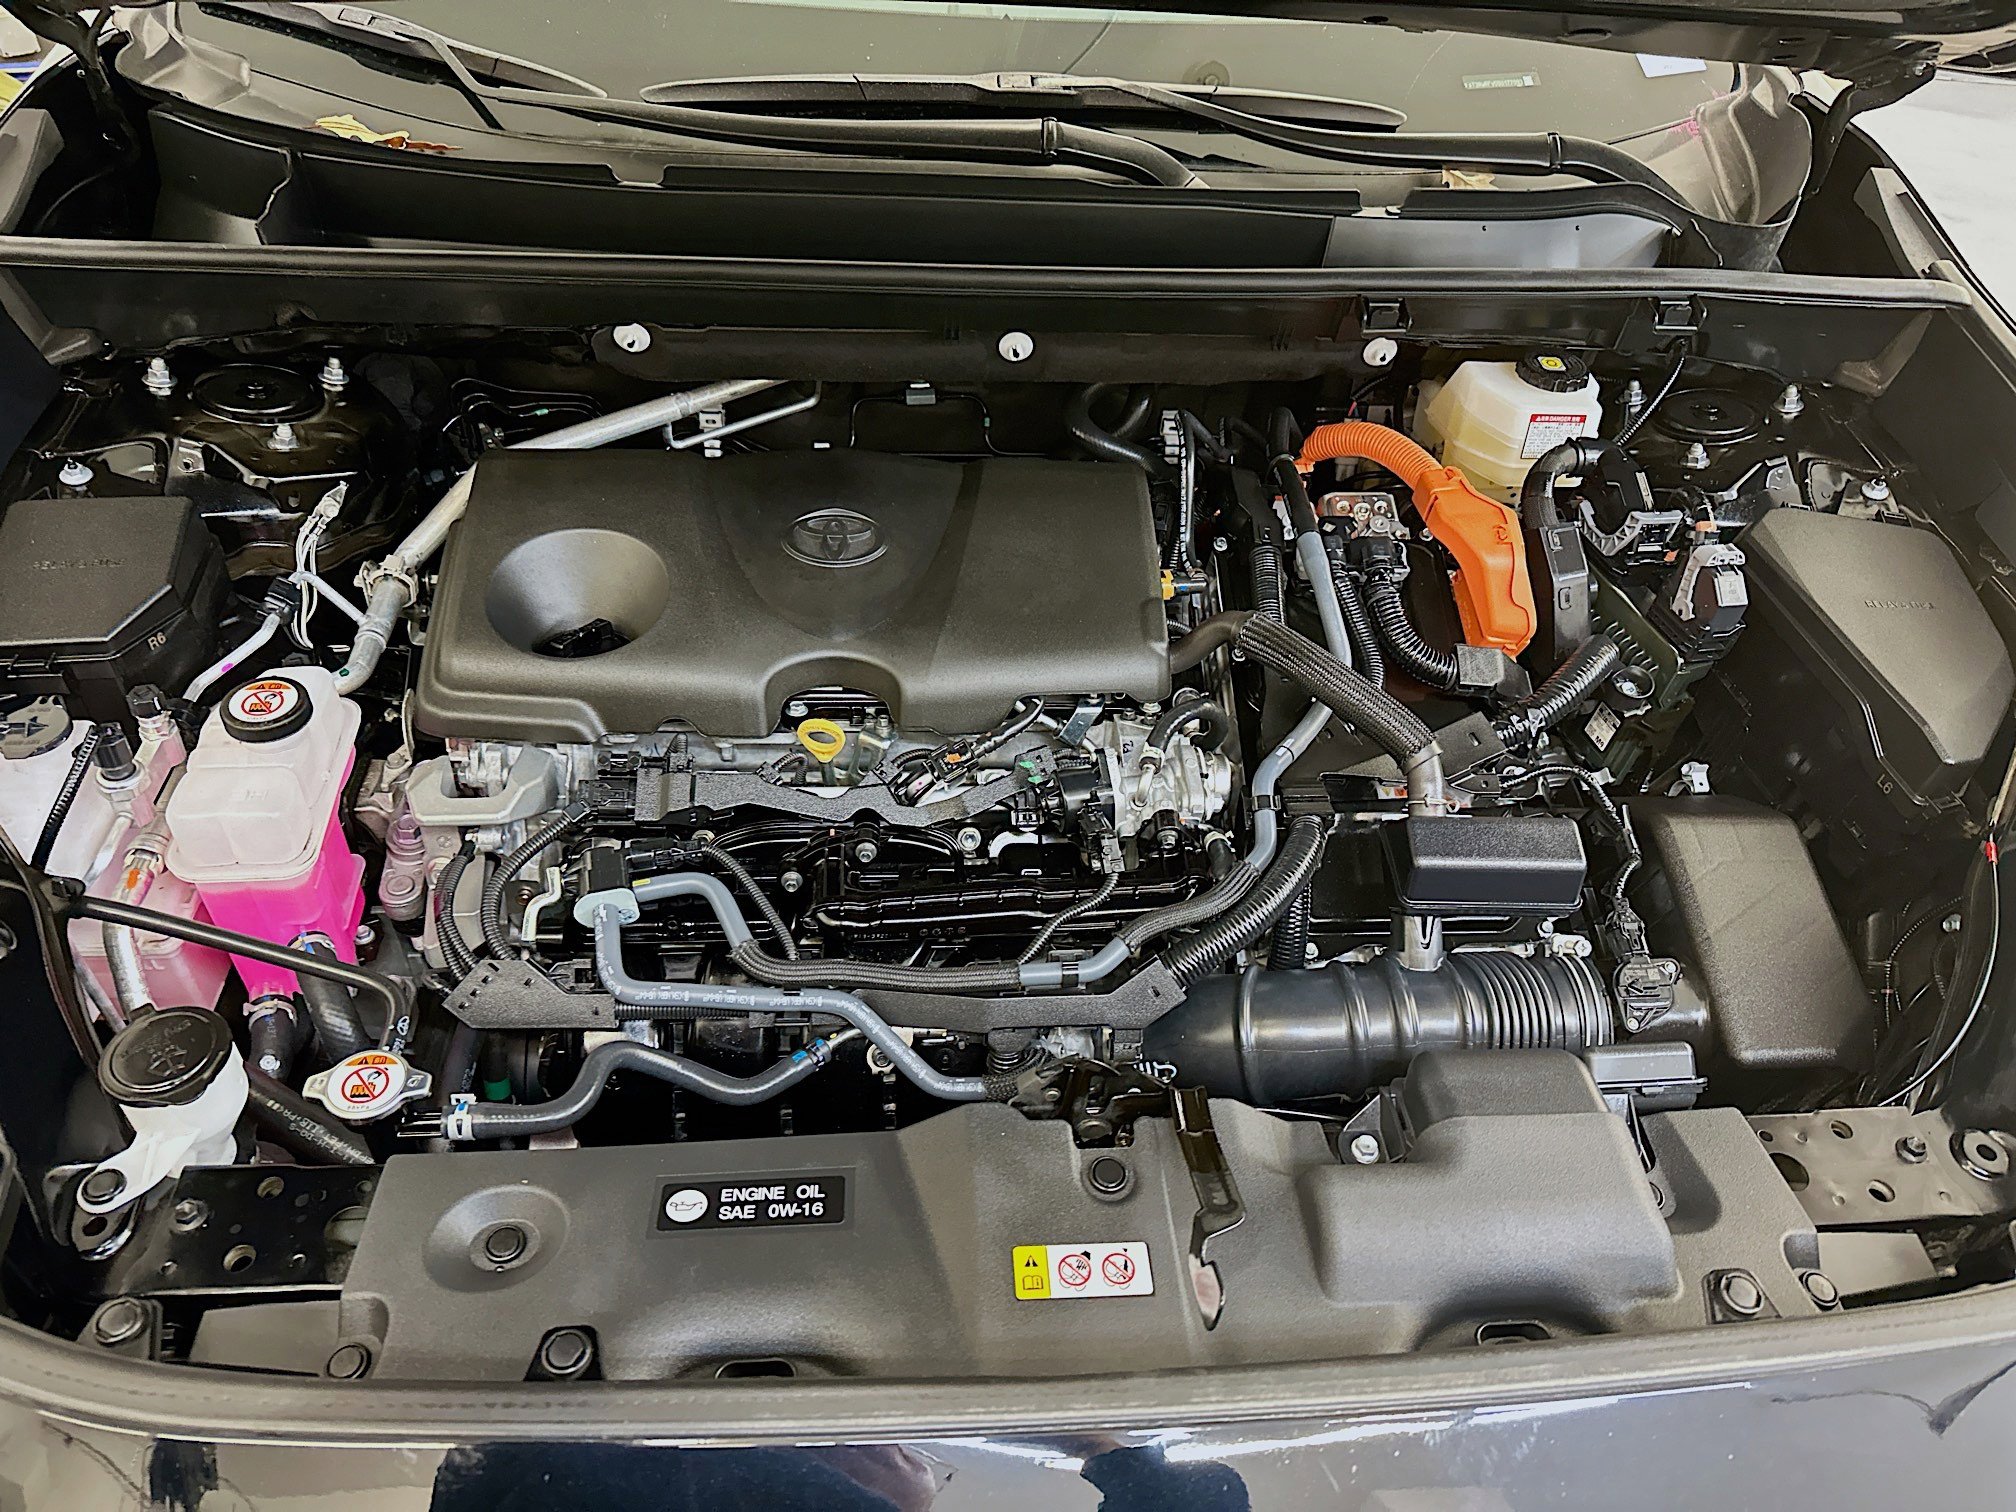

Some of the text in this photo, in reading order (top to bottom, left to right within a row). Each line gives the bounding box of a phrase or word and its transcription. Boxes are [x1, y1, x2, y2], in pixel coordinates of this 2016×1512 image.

[148, 631, 168, 651] R6
[1877, 773, 1894, 795] L6
[720, 1184, 825, 1202] ENGINE OIL
[718, 1202, 824, 1221] SAE 0W-16
